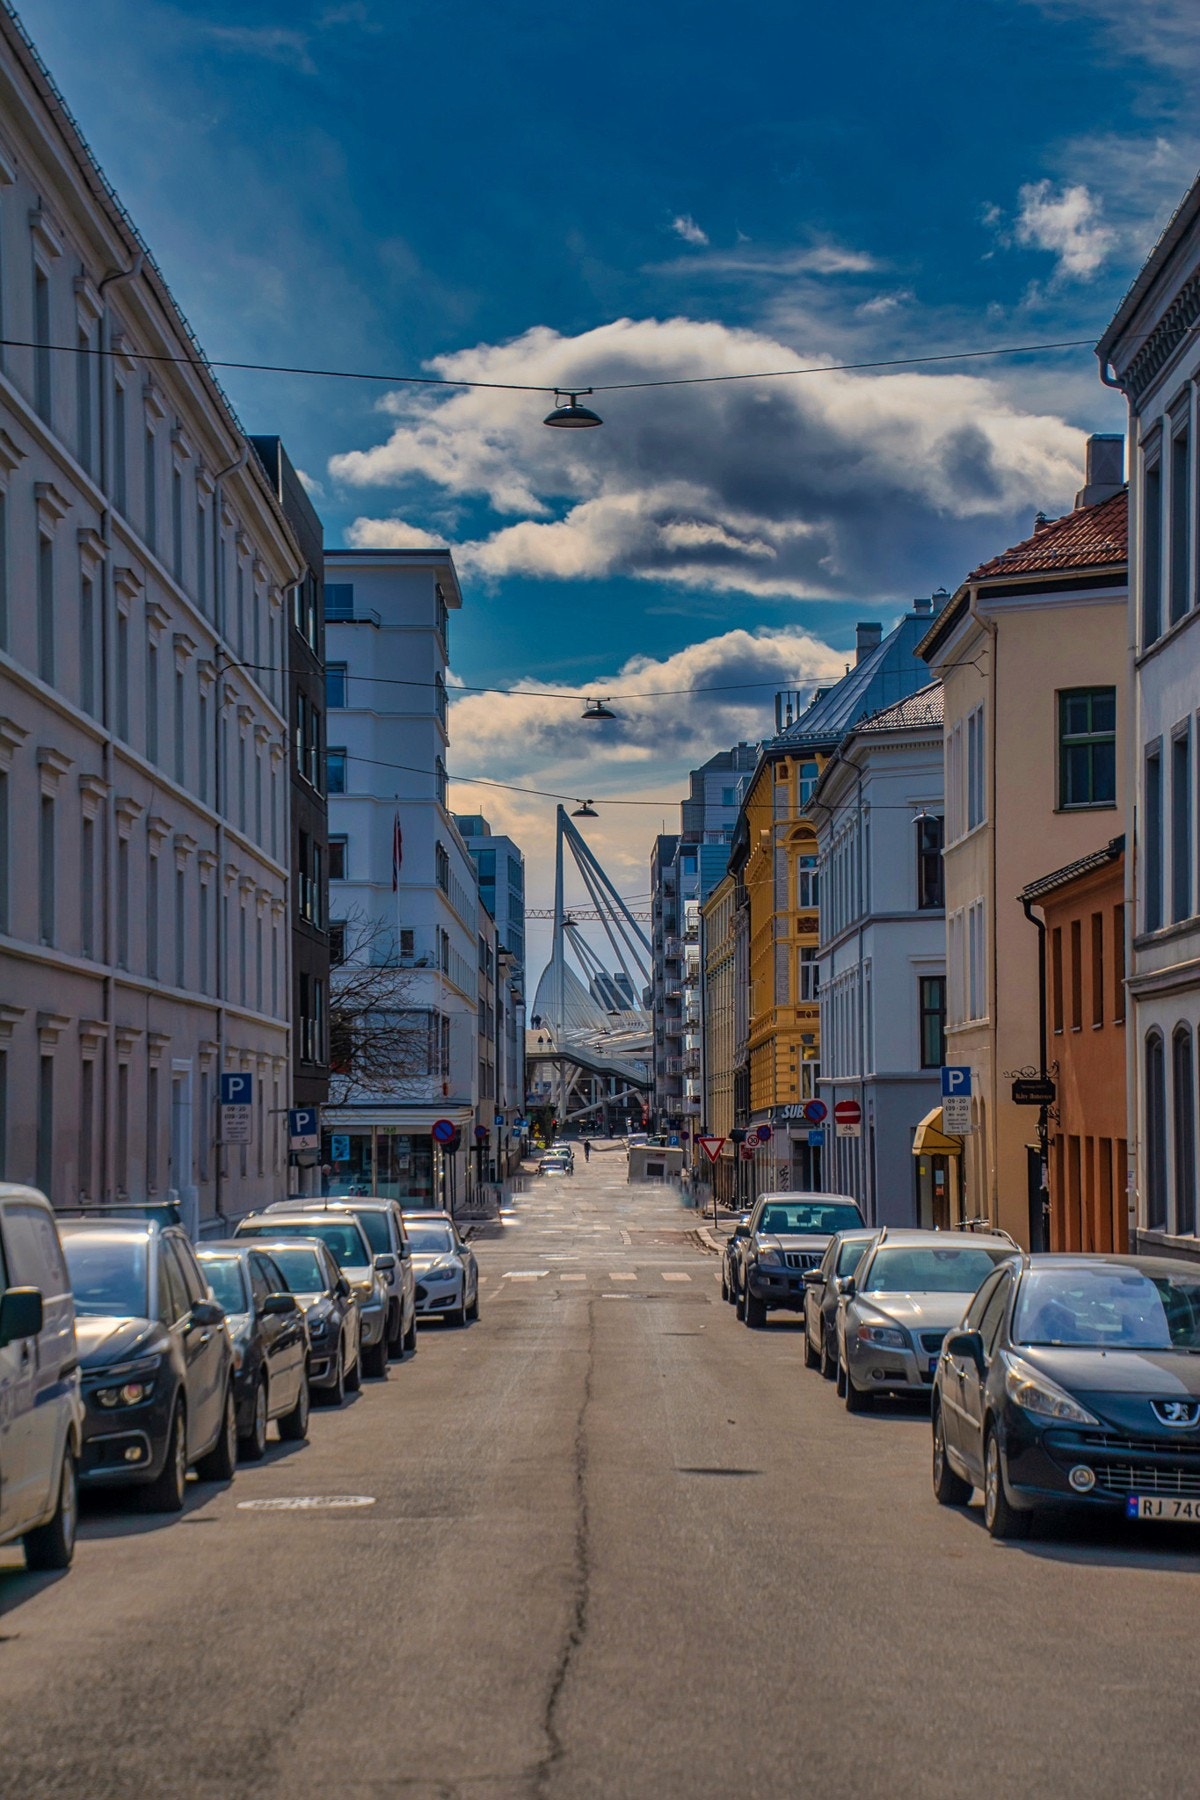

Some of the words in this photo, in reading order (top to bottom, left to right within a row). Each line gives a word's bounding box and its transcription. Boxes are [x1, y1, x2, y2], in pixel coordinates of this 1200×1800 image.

[228, 1077, 244, 1100] P
[948, 1070, 964, 1092] P
[781, 1104, 806, 1119] SUB
[296, 1112, 310, 1132] P
[1143, 1499, 1163, 1516] RJ
